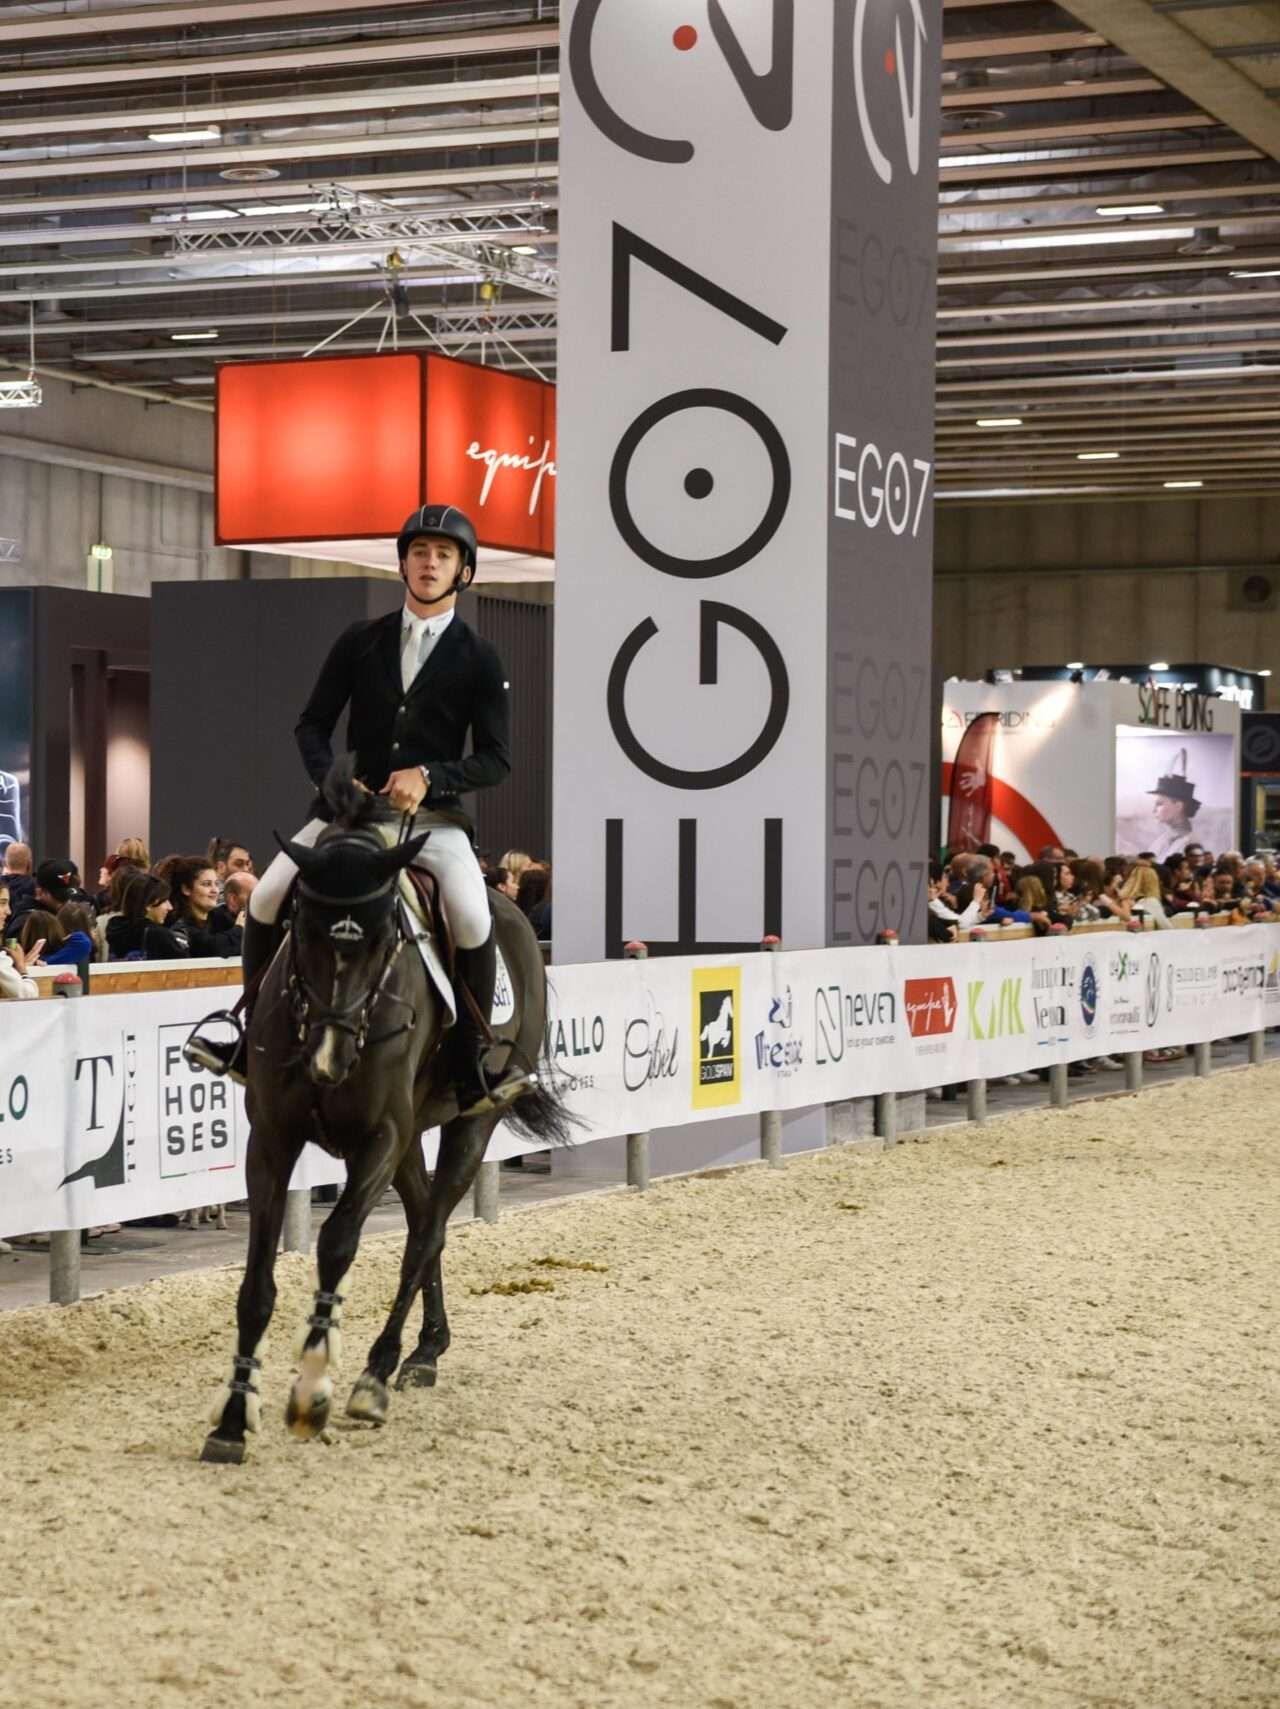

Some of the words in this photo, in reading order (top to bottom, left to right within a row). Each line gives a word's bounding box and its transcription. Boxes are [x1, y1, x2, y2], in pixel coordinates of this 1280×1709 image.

[834, 432, 931, 537] EGO7
[604, 221, 789, 960] EGO7
[165, 1080, 227, 1116] HOR
[167, 1119, 228, 1156] SES
